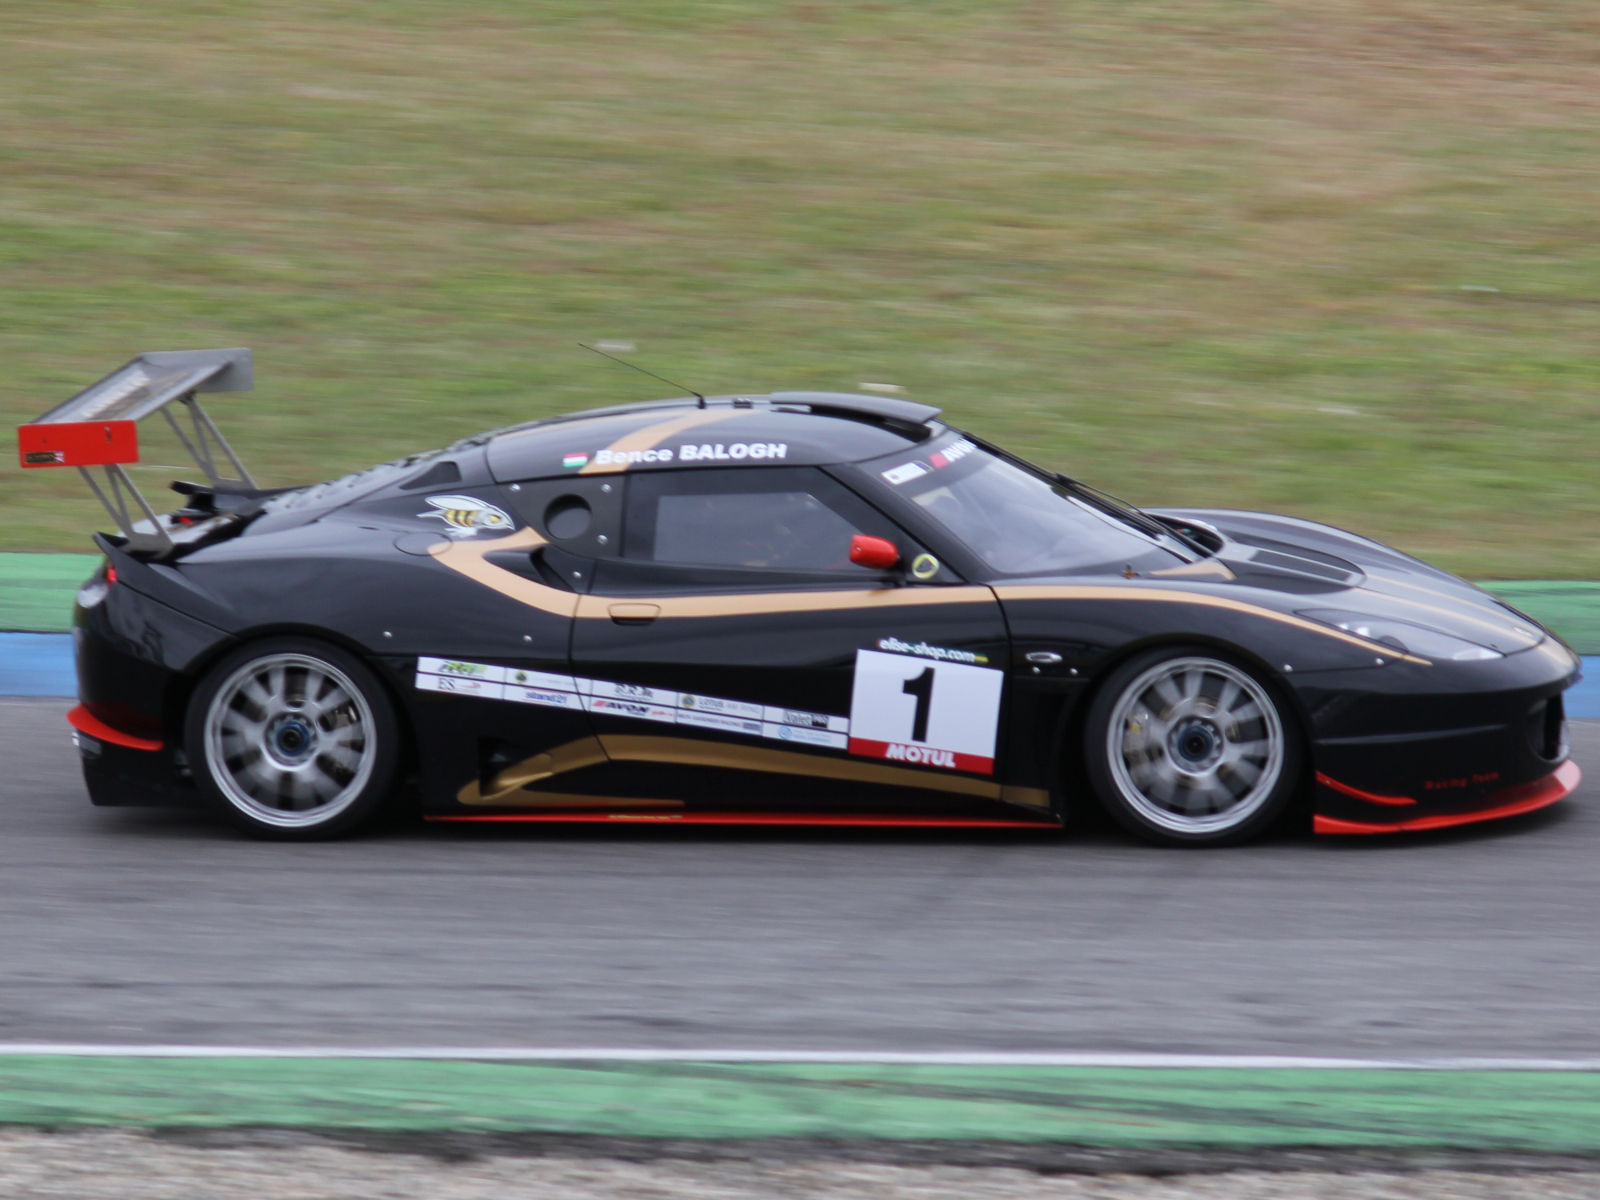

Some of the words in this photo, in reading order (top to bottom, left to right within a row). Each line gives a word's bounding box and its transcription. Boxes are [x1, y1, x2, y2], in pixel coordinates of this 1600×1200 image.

[594, 448, 674, 465] Bence
[679, 442, 788, 460] BALOGH
[879, 636, 976, 662] elise-shop.com
[605, 701, 650, 713] AVON
[902, 666, 936, 743] 1
[885, 743, 956, 769] MOTUL
